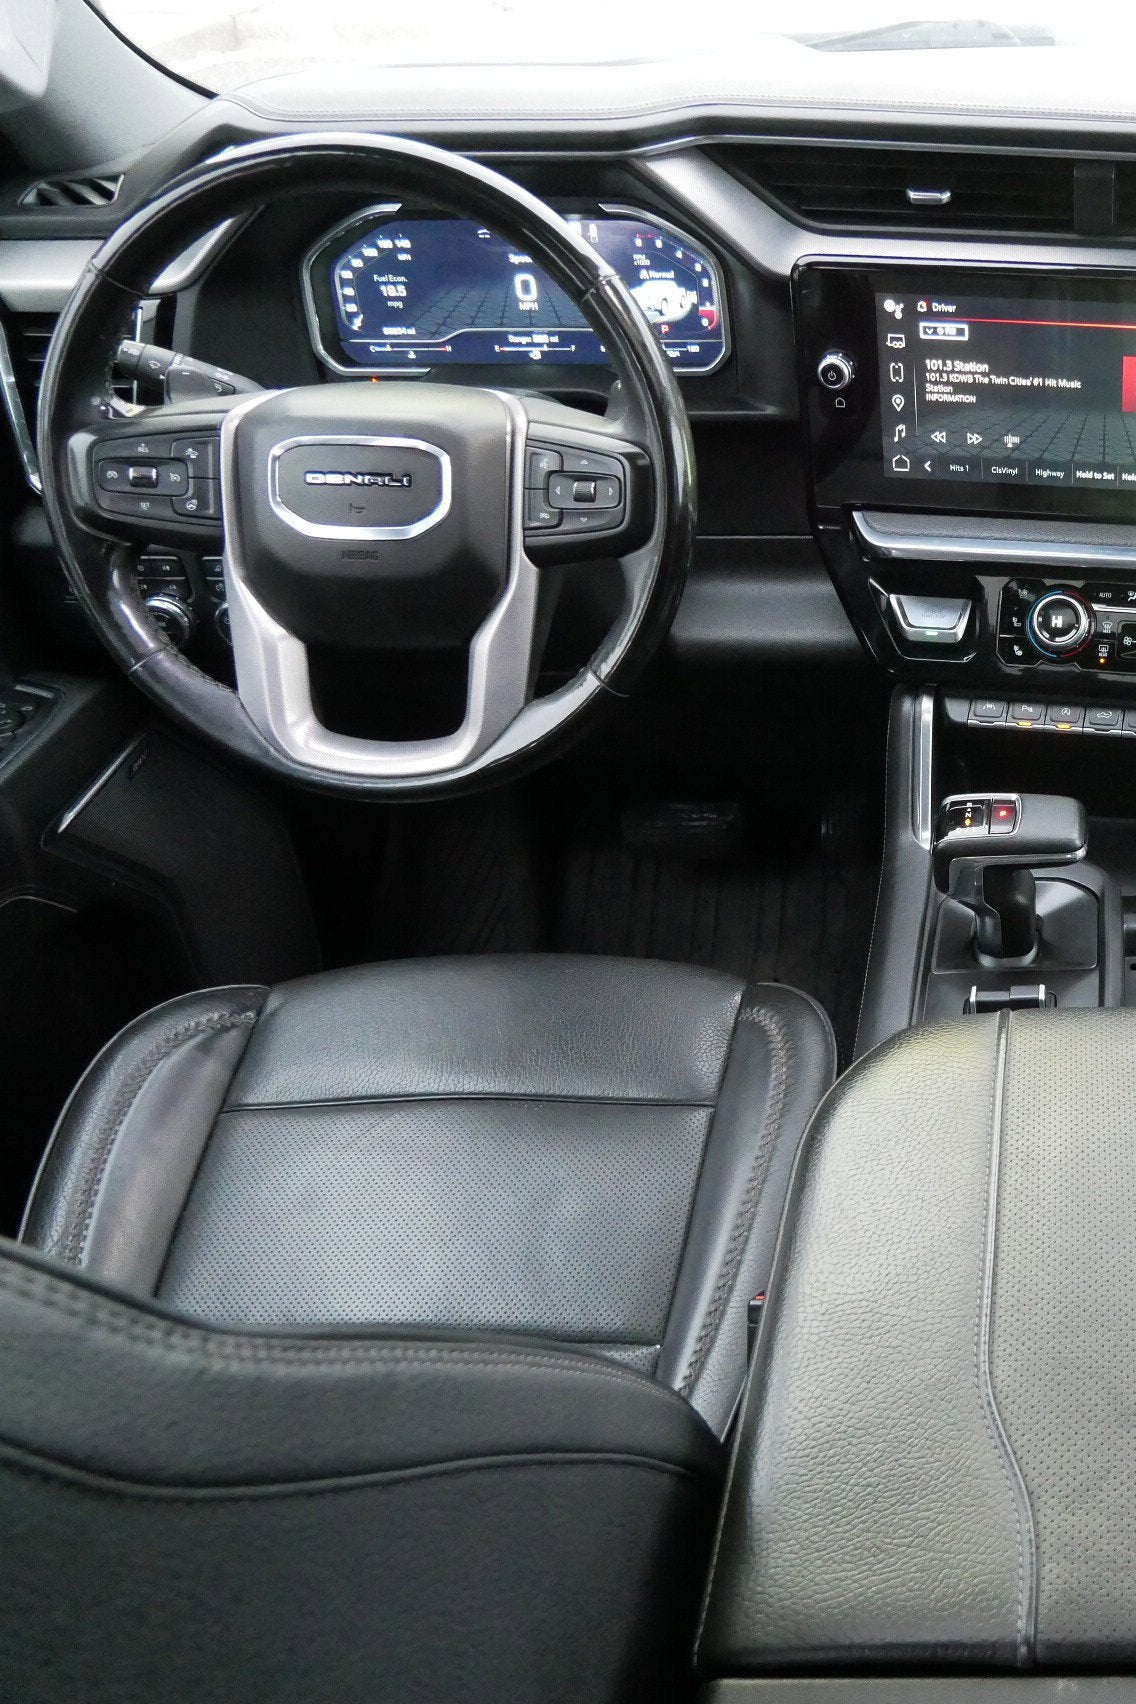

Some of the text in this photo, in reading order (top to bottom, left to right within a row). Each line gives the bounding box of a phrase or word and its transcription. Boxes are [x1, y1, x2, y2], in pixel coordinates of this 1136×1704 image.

[373, 274, 408, 282] Fuel Econ.
[514, 273, 538, 302] 0
[387, 301, 404, 309] mpg
[519, 301, 539, 311] MPH
[931, 302, 957, 313] Driver
[661, 324, 669, 334] P
[925, 359, 989, 373] 101.3 Station
[925, 373, 948, 382] 101.3
[949, 373, 973, 383] KDWB
[975, 375, 989, 384] The
[989, 375, 1008, 385] Twin
[1033, 377, 1043, 387] #1
[1045, 378, 1057, 388] Hit
[1058, 379, 1082, 389] Music
[925, 383, 953, 393] Station
[925, 393, 977, 404] INFORMATION
[949, 464, 964, 472] Hits
[1035, 469, 1065, 479] Highway
[1076, 470, 1115, 481] Hold to Set
[304, 471, 412, 488] DENALI
